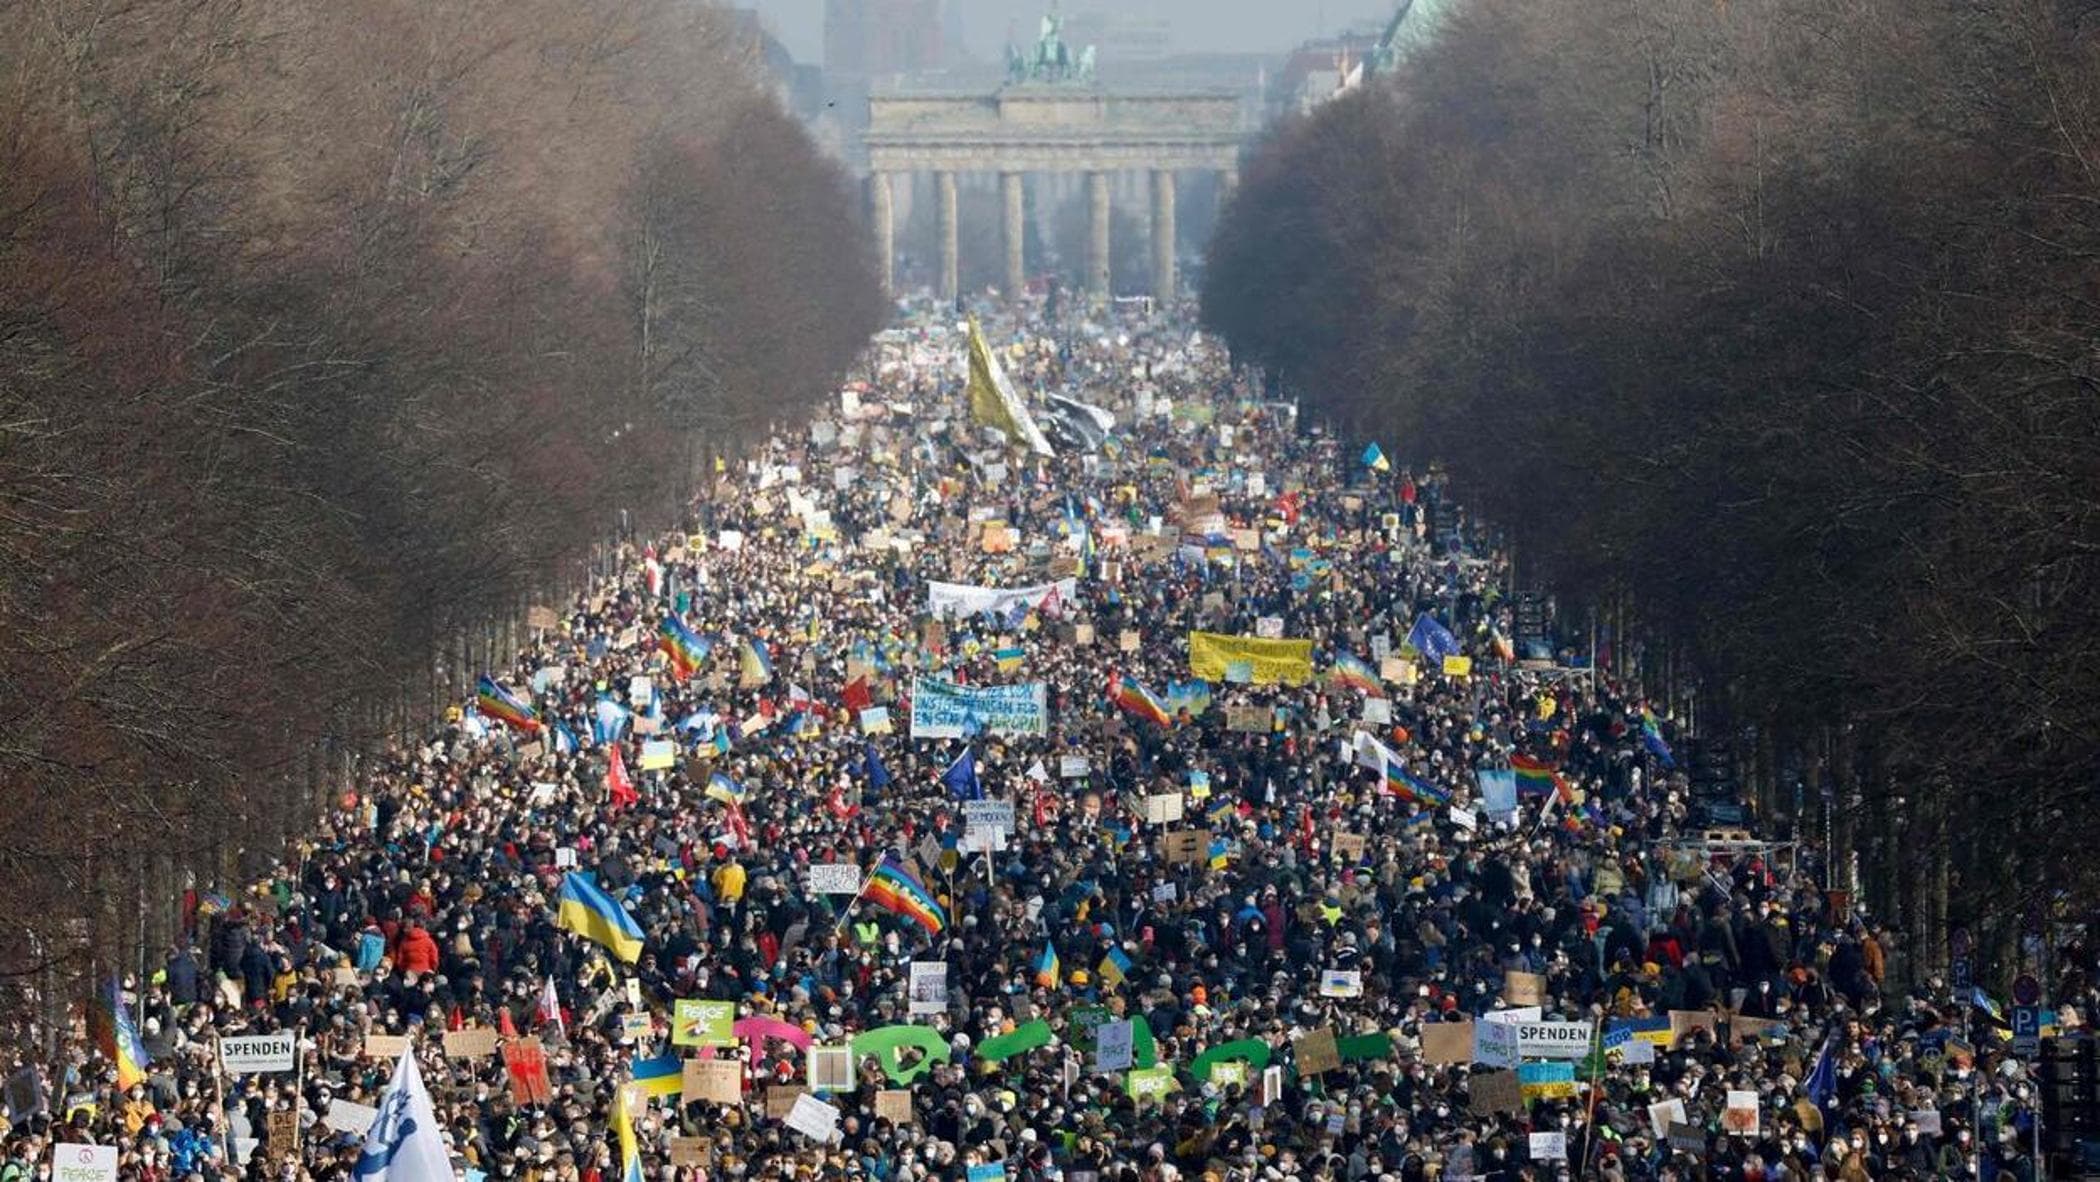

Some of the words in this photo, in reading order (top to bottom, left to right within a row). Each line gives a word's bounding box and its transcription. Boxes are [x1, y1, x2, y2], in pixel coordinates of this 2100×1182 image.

[2017, 1009, 2032, 1033] P
[1520, 1026, 1588, 1041] SPENDEN
[224, 1041, 291, 1057] SPENDEN
[61, 1166, 109, 1181] PEACE
